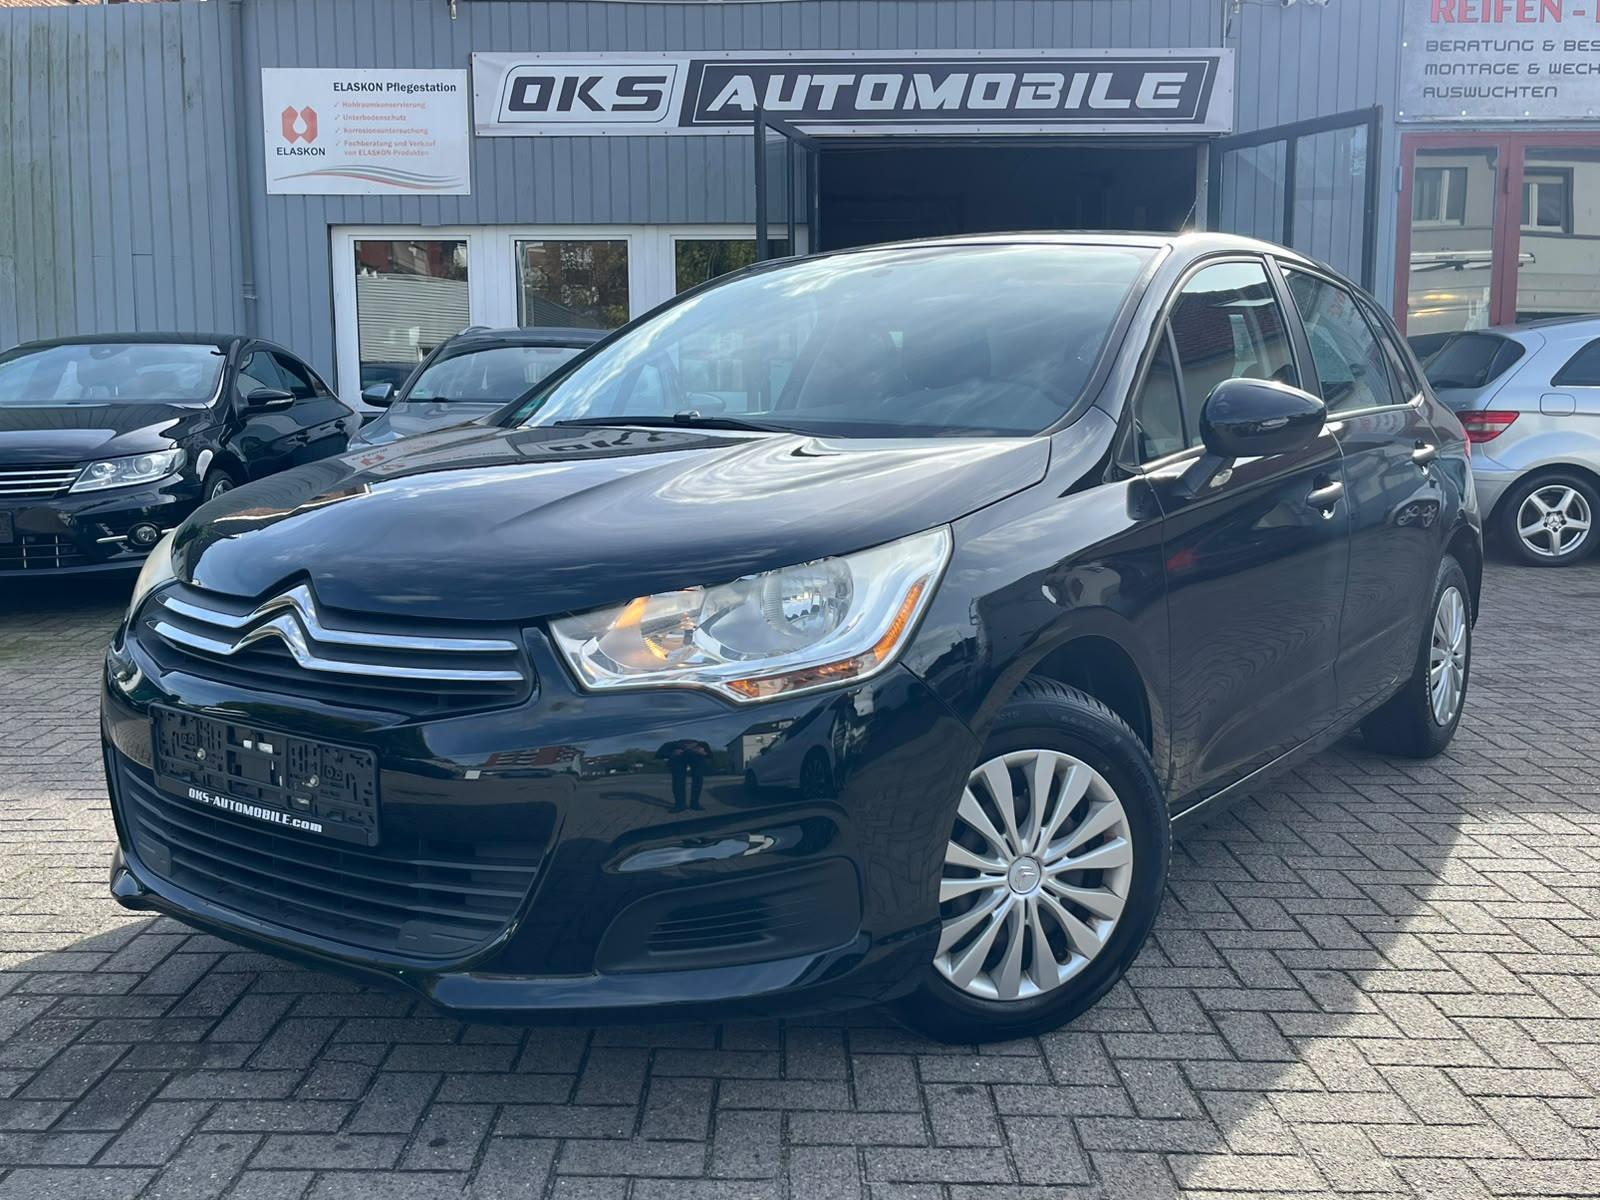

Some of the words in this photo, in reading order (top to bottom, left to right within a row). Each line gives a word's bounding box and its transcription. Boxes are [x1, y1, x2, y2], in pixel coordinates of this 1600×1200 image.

[1430, 0, 1562, 23] REIFEN
[1426, 40, 1534, 52] BERATUNG
[1542, 40, 1555, 51] &
[1564, 40, 1600, 51] BES
[1424, 63, 1519, 75] MONTAGE
[1527, 63, 1540, 75] &
[1549, 63, 1600, 75] WECH
[333, 82, 383, 92] ELASKON
[386, 82, 457, 94] Pflegestation
[508, 75, 667, 111] OKS
[706, 73, 1188, 111] AUTOMOBILE
[1423, 86, 1558, 98] AUSWUCHTEN
[344, 140, 393, 148] Fachberatung
[276, 147, 326, 156] ELASKON
[188, 787, 323, 832] OKS-AUTOMOBILE.com
